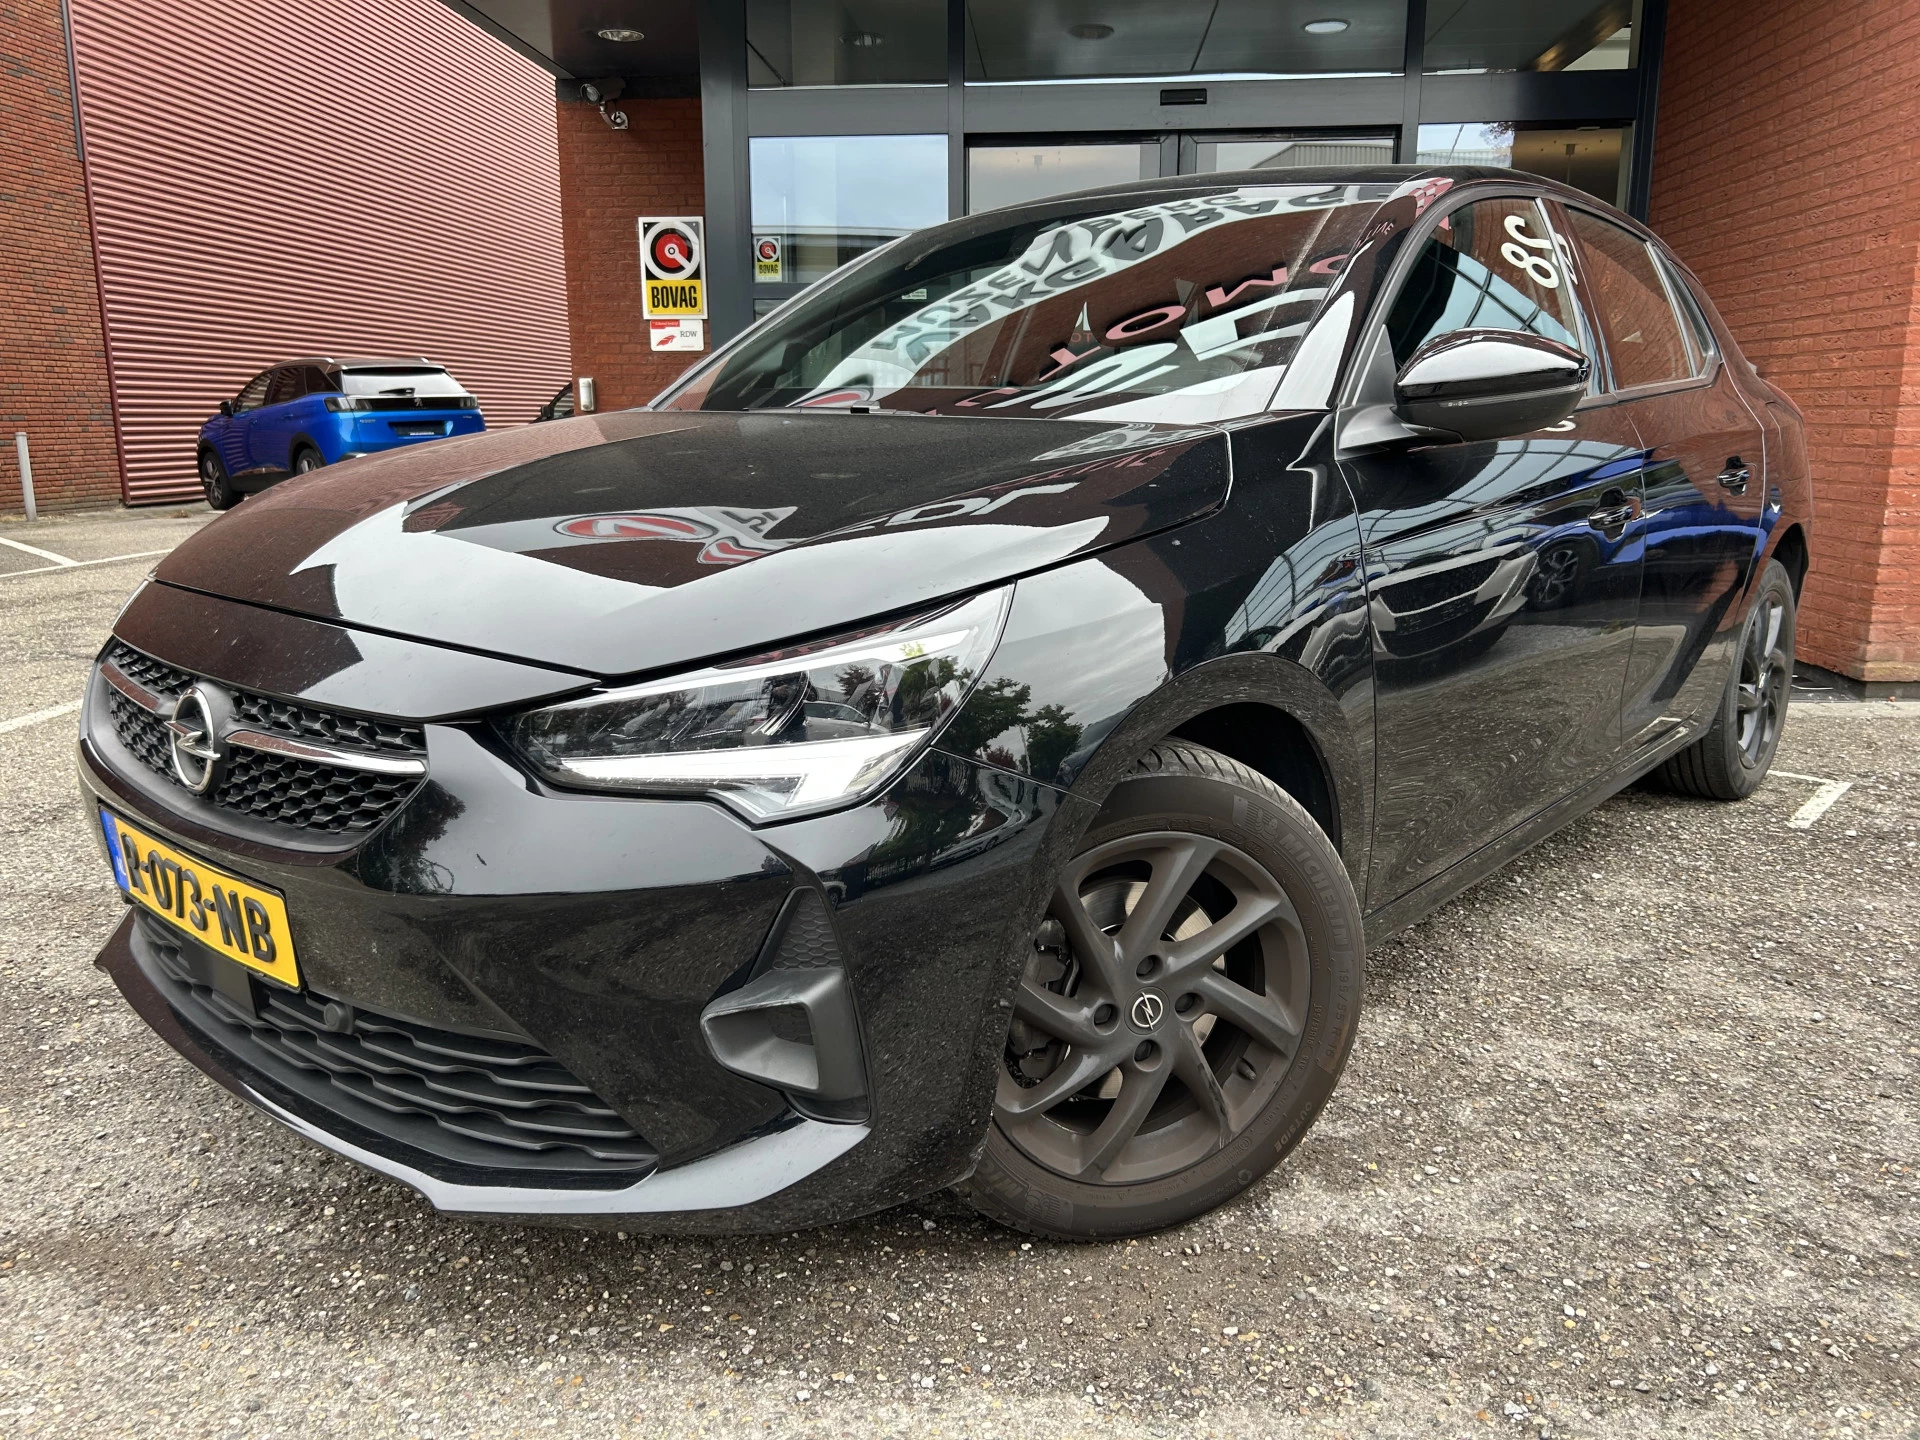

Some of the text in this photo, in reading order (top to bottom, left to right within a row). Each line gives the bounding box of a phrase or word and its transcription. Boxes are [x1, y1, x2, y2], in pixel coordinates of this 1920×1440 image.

[758, 264, 779, 274] BOVAG
[651, 286, 697, 308] BOVAG
[120, 832, 276, 963] R-073-NB
[1279, 833, 1348, 945] MICHELIN
[1273, 1101, 1314, 1152] OUTSIDE
